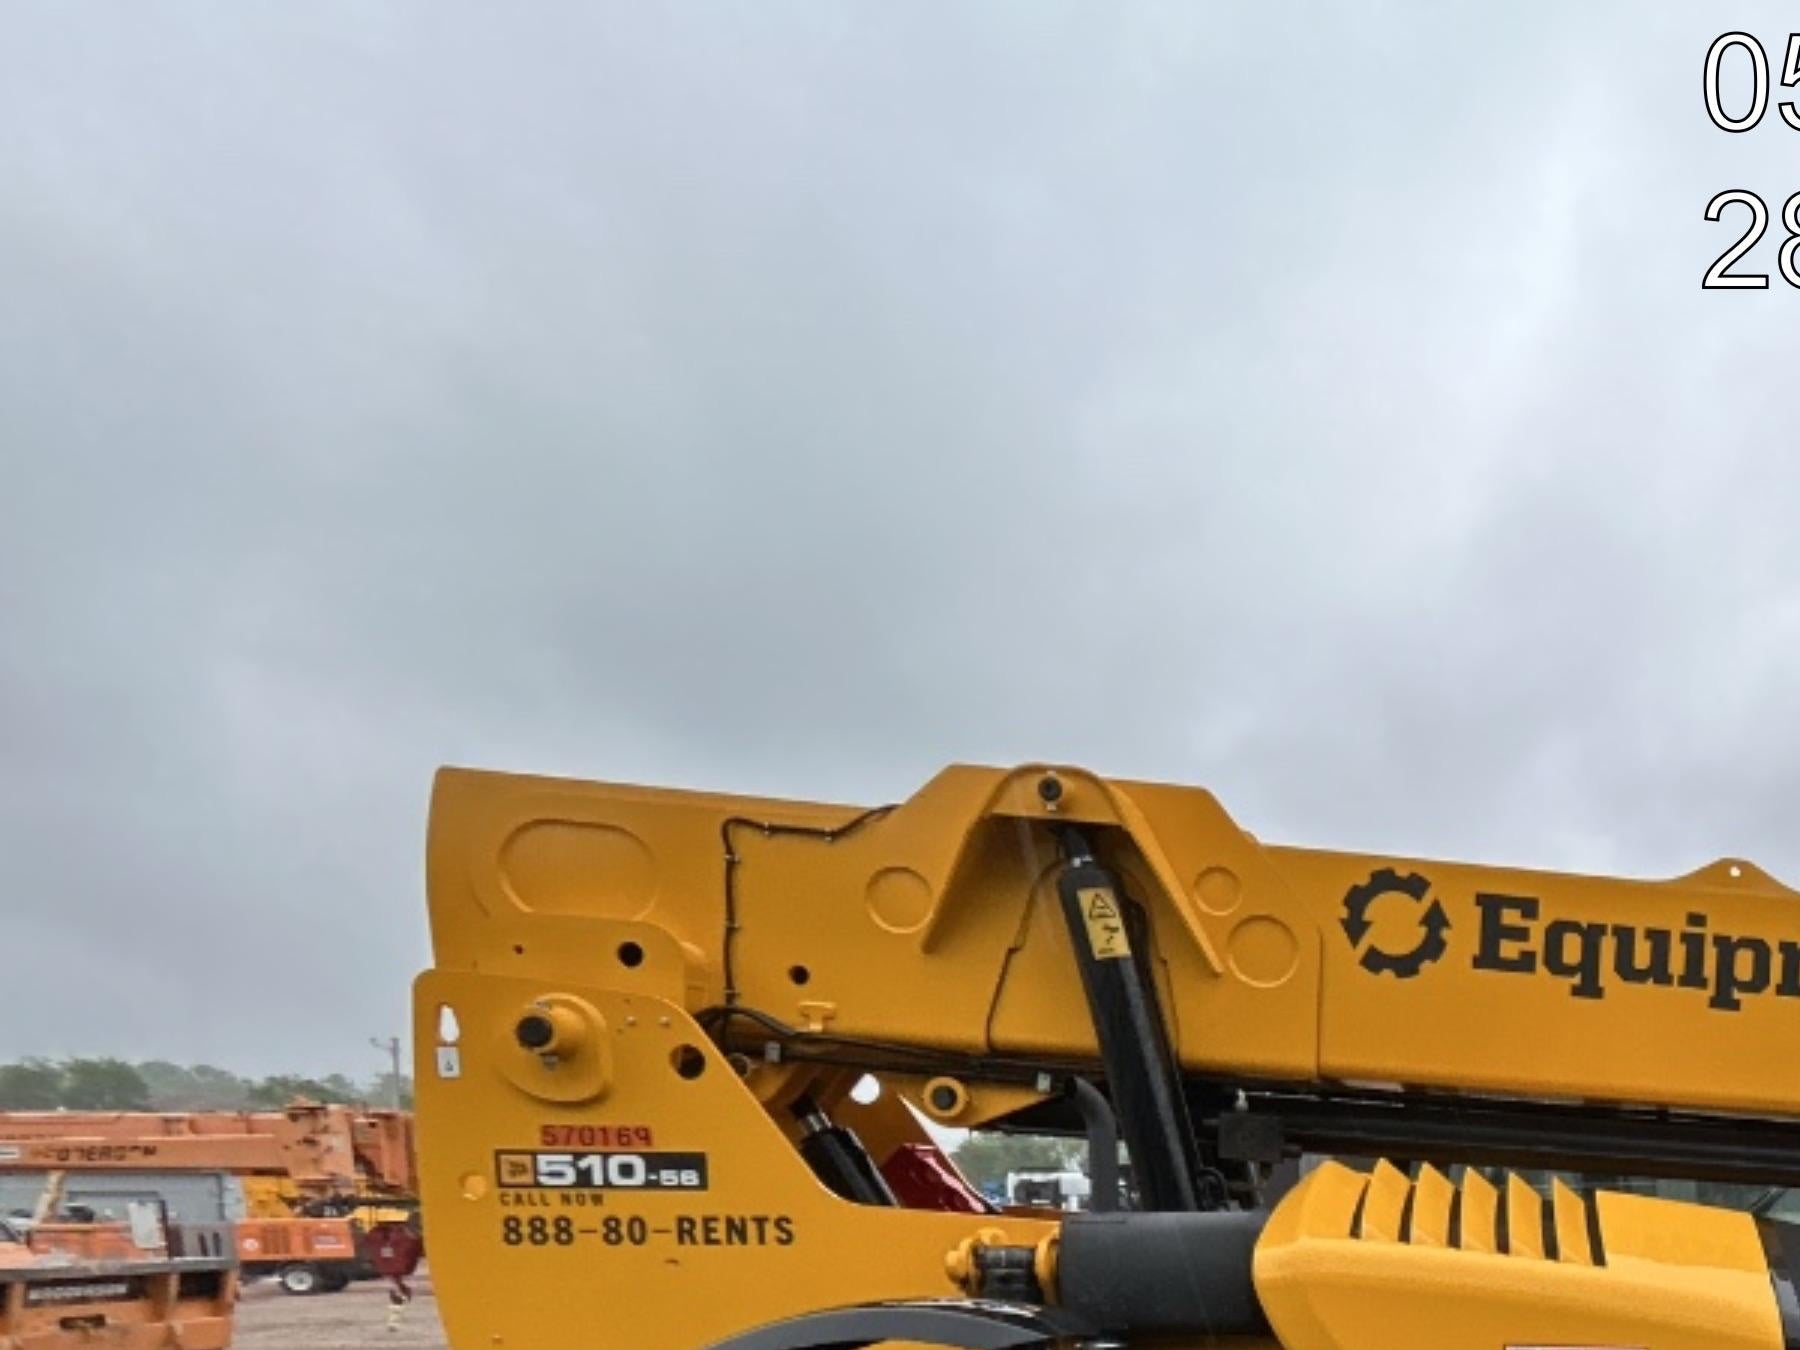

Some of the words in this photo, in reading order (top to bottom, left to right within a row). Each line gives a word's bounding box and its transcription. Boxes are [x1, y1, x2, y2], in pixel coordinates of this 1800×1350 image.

[540, 1123, 653, 1147] 570169
[500, 1192, 551, 1207] CALL
[560, 1193, 605, 1207] NOW
[503, 1215, 796, 1247] 888-80-RENTS
